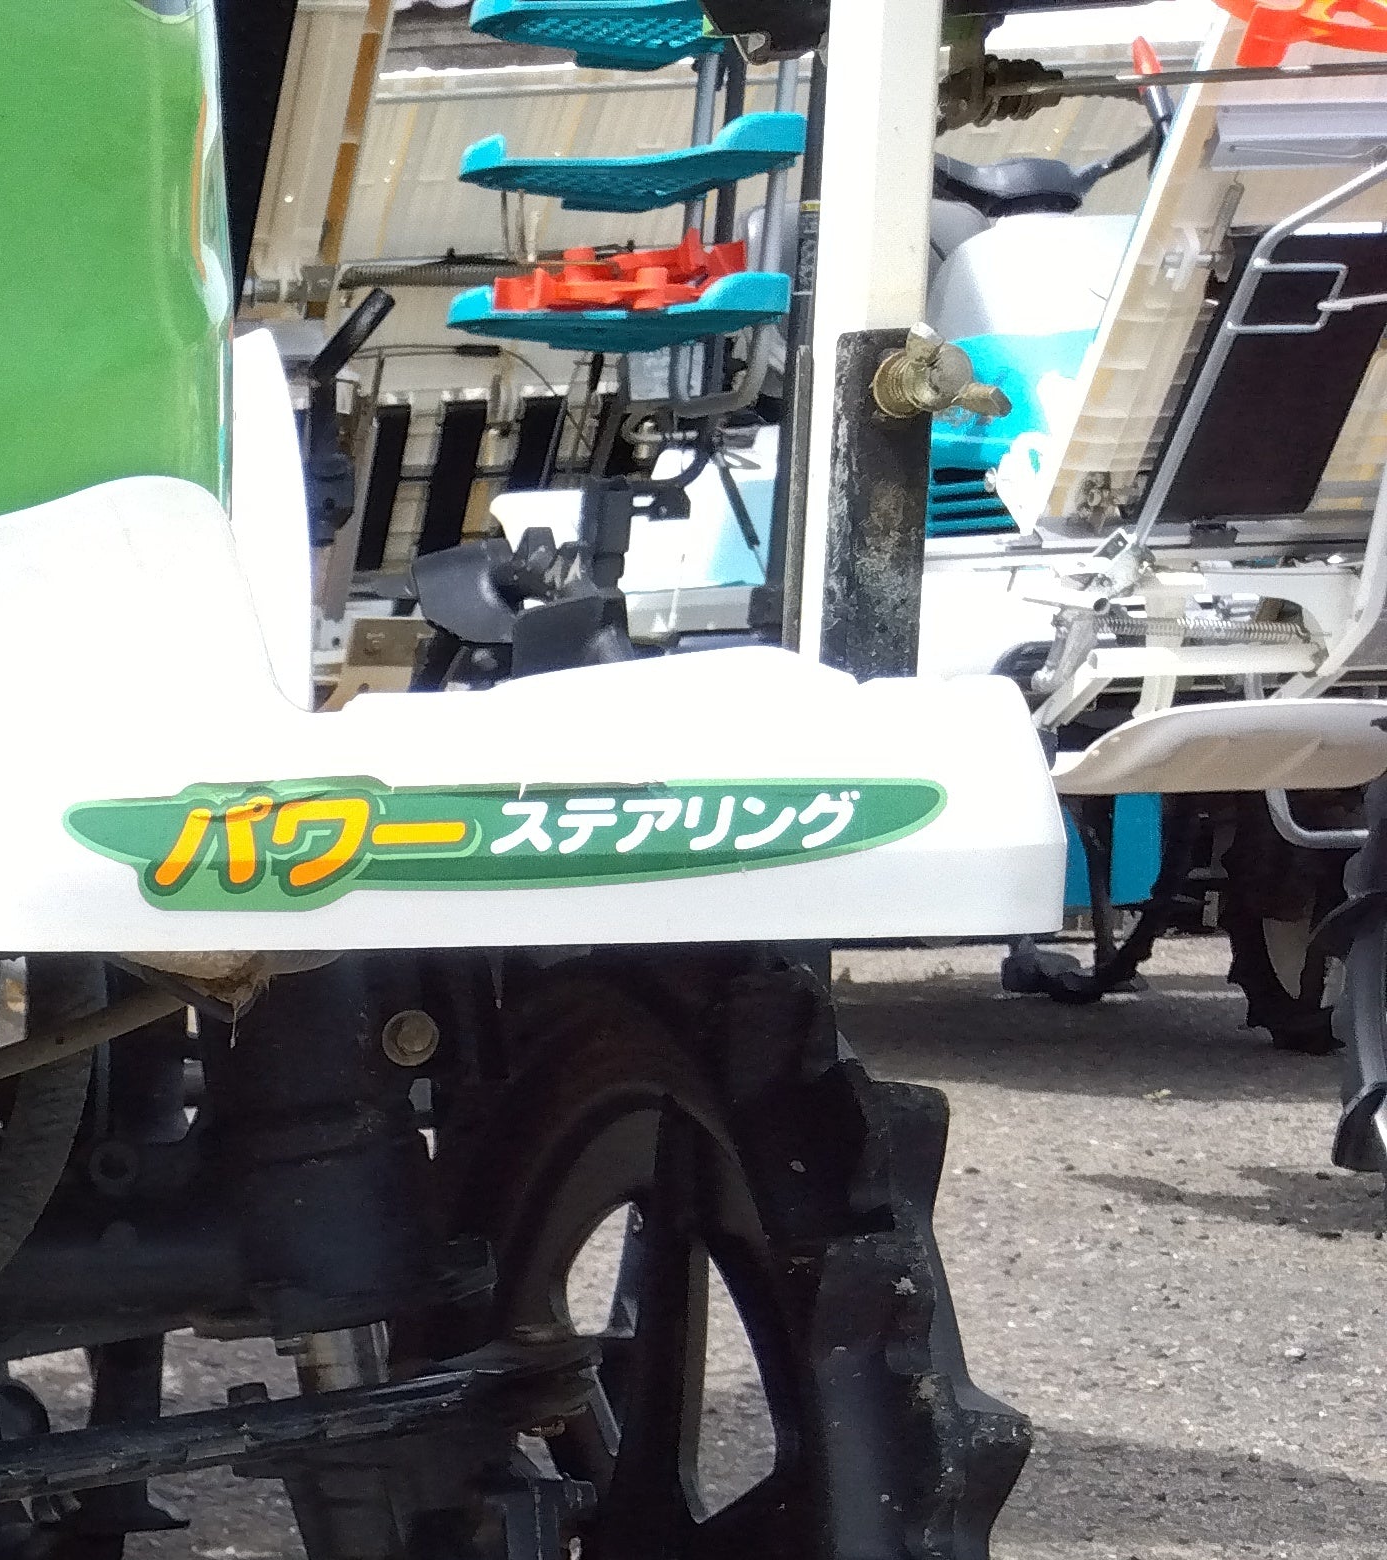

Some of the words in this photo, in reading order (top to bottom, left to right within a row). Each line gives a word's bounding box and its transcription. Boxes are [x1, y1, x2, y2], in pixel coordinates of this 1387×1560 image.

[155, 796, 466, 887] パワー
[490, 790, 861, 855] ステアリング
